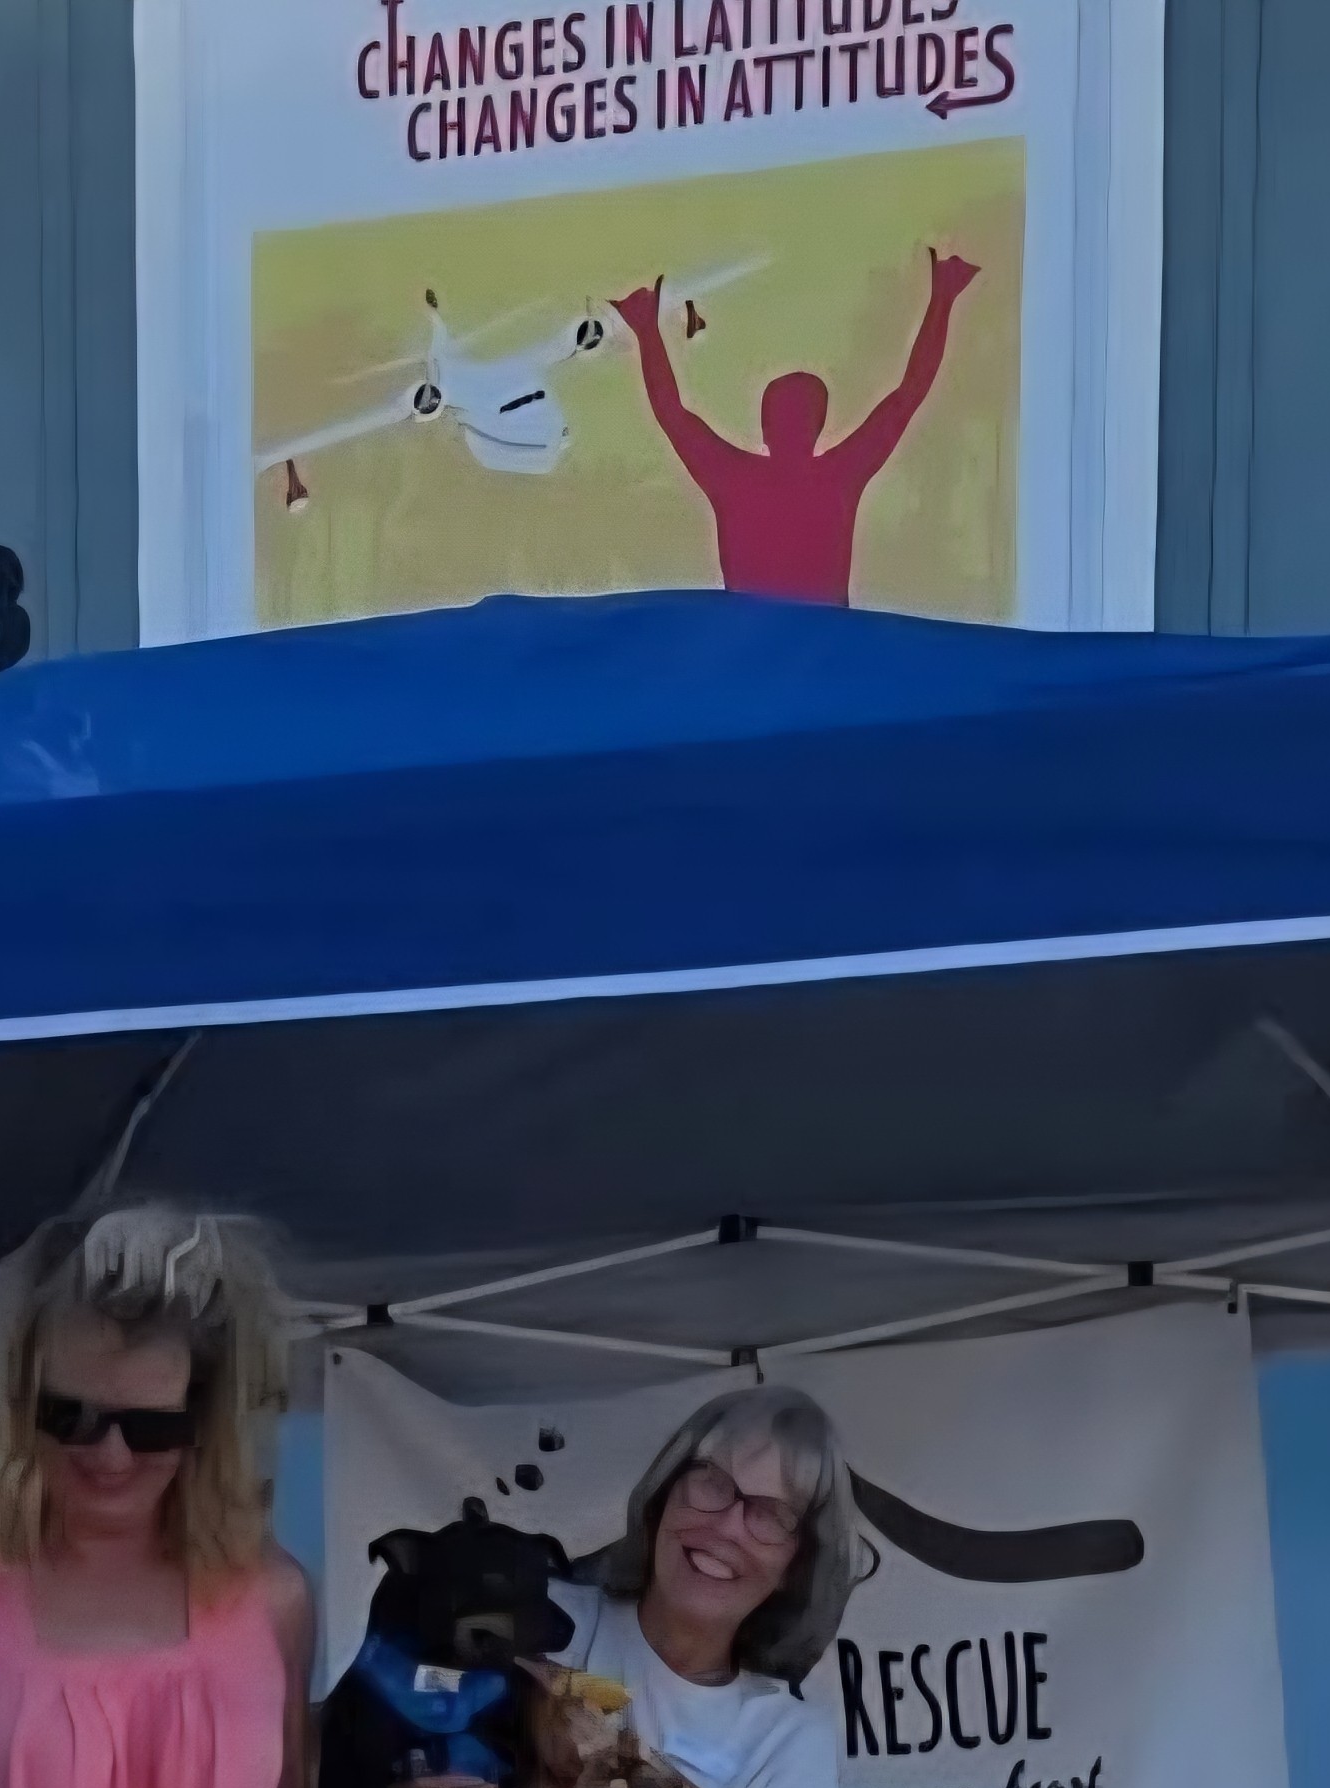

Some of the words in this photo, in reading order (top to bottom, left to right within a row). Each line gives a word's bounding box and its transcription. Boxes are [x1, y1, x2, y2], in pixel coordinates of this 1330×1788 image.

[357, 4, 587, 99] CHANGES
[605, 1, 655, 69] IN
[407, 75, 638, 162] CHANGES
[656, 63, 708, 129] IN
[723, 24, 1015, 121] ATTITUDES
[837, 1630, 1053, 1759] RESCUE
